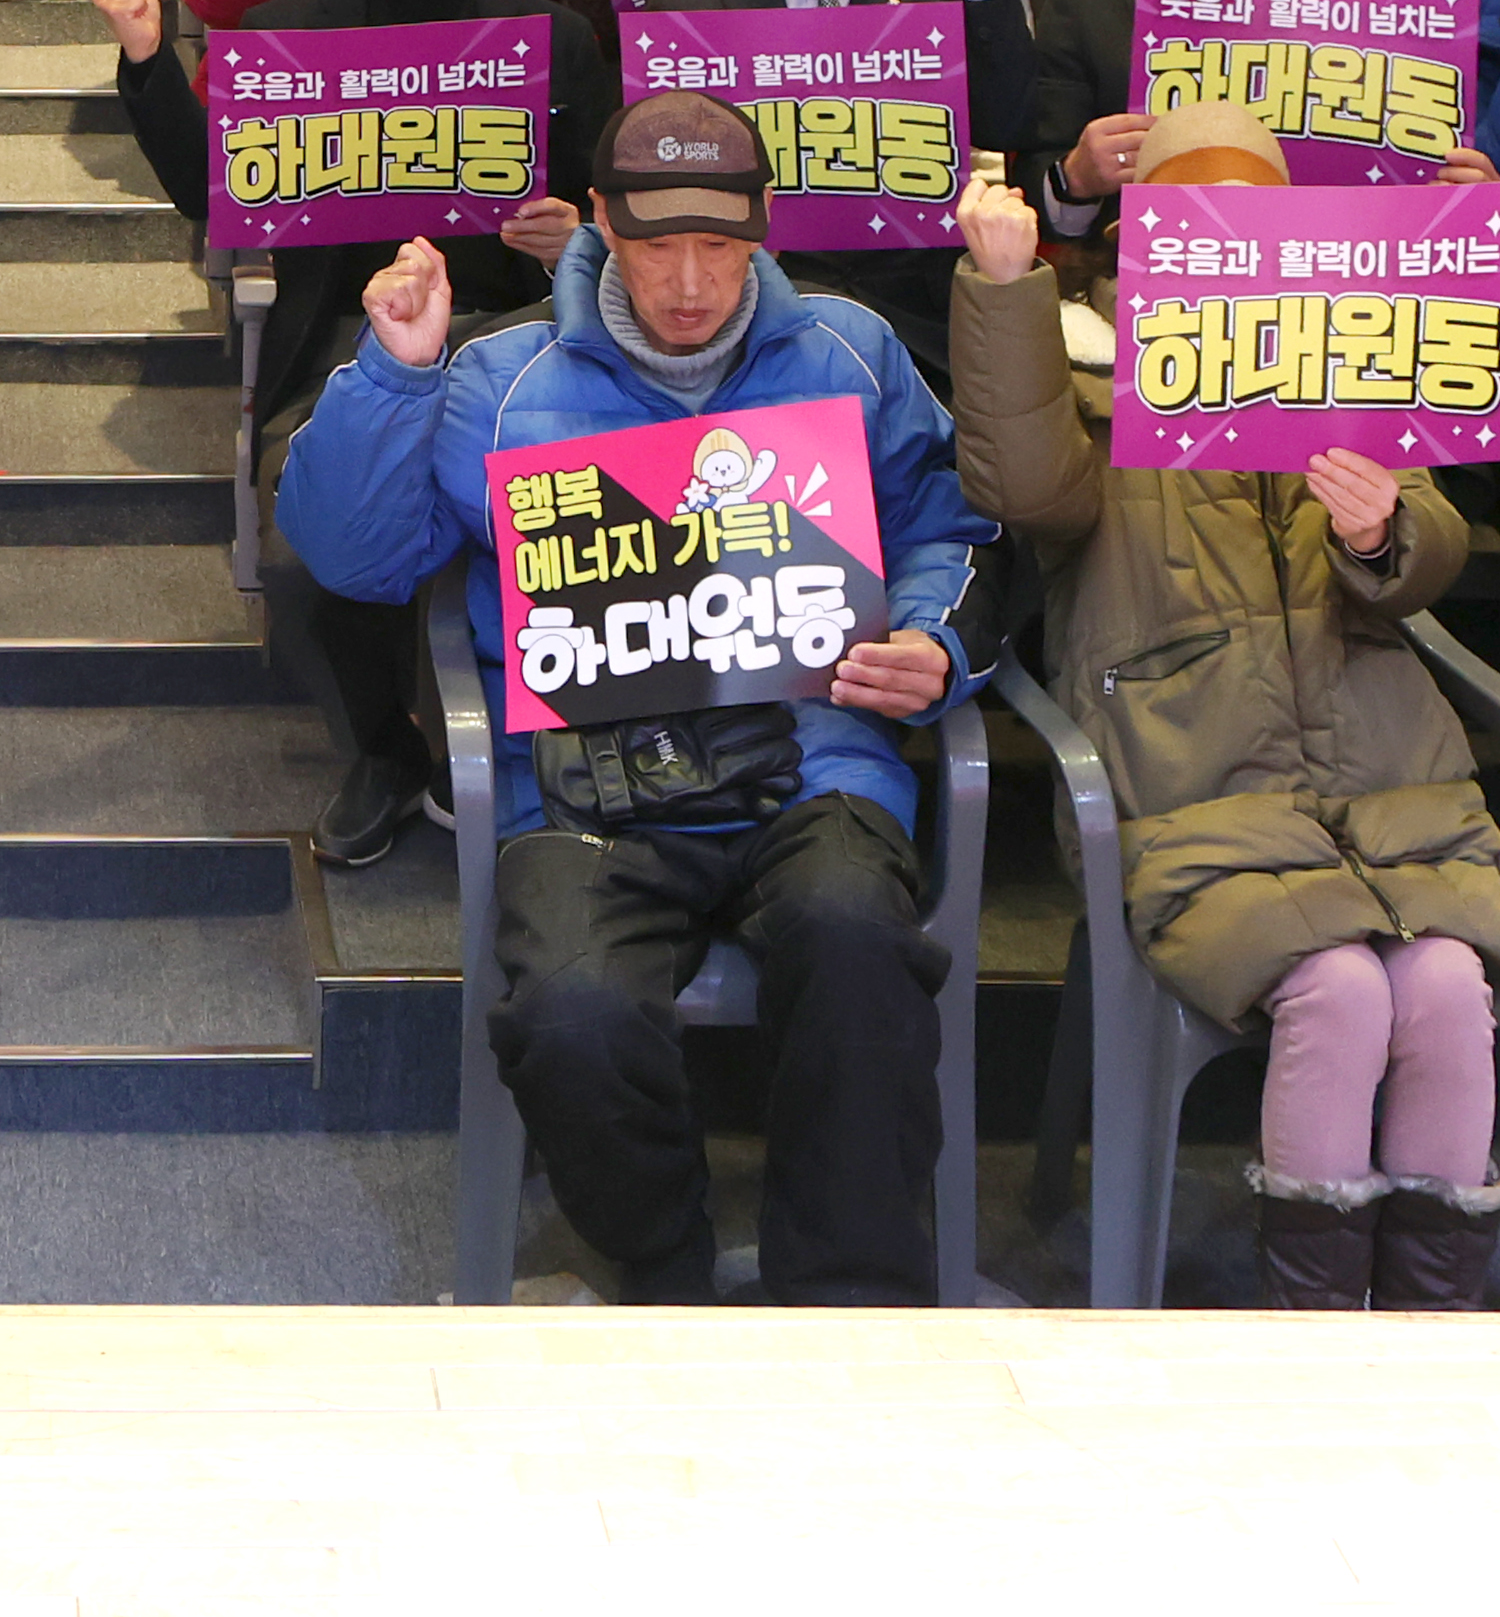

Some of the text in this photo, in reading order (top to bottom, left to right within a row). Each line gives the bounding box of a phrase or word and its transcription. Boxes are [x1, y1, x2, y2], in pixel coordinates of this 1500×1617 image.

[1368, 0, 1456, 41] 넘치는
[232, 59, 528, 101] 웃음과 활력이 넘치는
[645, 47, 944, 91] 웃음과 활력이 넘치는
[224, 104, 534, 207] 하대원동
[683, 142, 719, 151] WORLD
[684, 151, 719, 160] SPORTS
[1147, 236, 1262, 281] 웃음과
[1278, 239, 1386, 281] 활력이
[505, 463, 604, 533] 행복
[512, 498, 793, 596] 에너지 가득!
[514, 562, 857, 694] 하대원동
